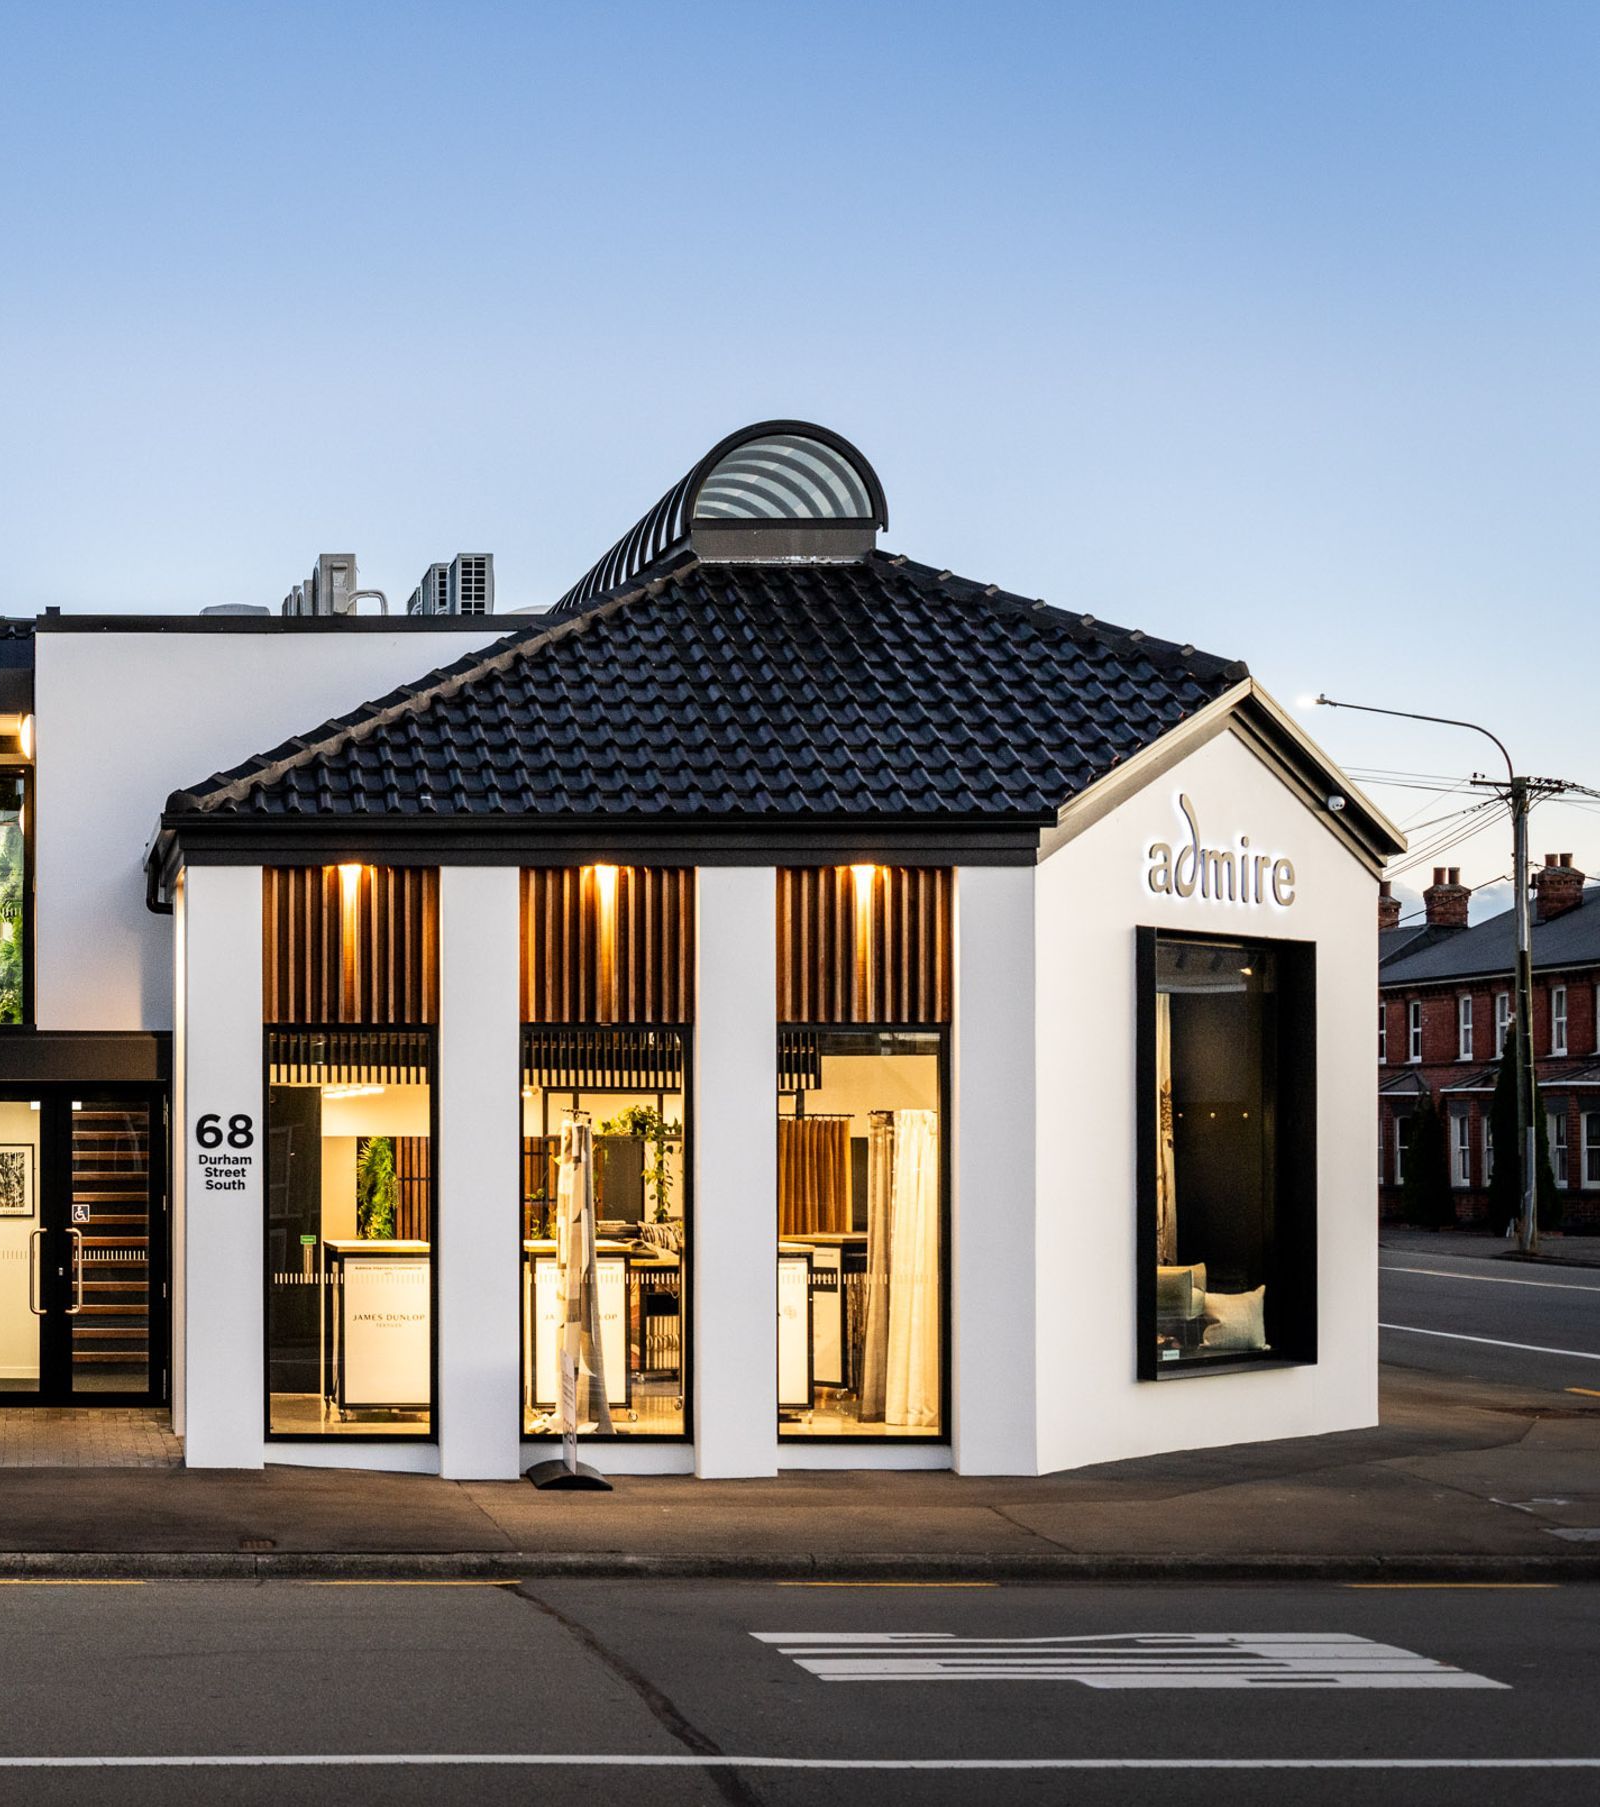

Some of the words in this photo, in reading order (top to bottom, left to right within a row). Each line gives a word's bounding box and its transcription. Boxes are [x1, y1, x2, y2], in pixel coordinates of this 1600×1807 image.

[1148, 793, 1296, 907] admire
[196, 1113, 254, 1149] 68
[198, 1153, 252, 1165] Durham
[204, 1166, 247, 1178] Street
[205, 1179, 246, 1190] South
[352, 1313, 383, 1322] JAMES
[386, 1313, 426, 1321] DUNLOP
